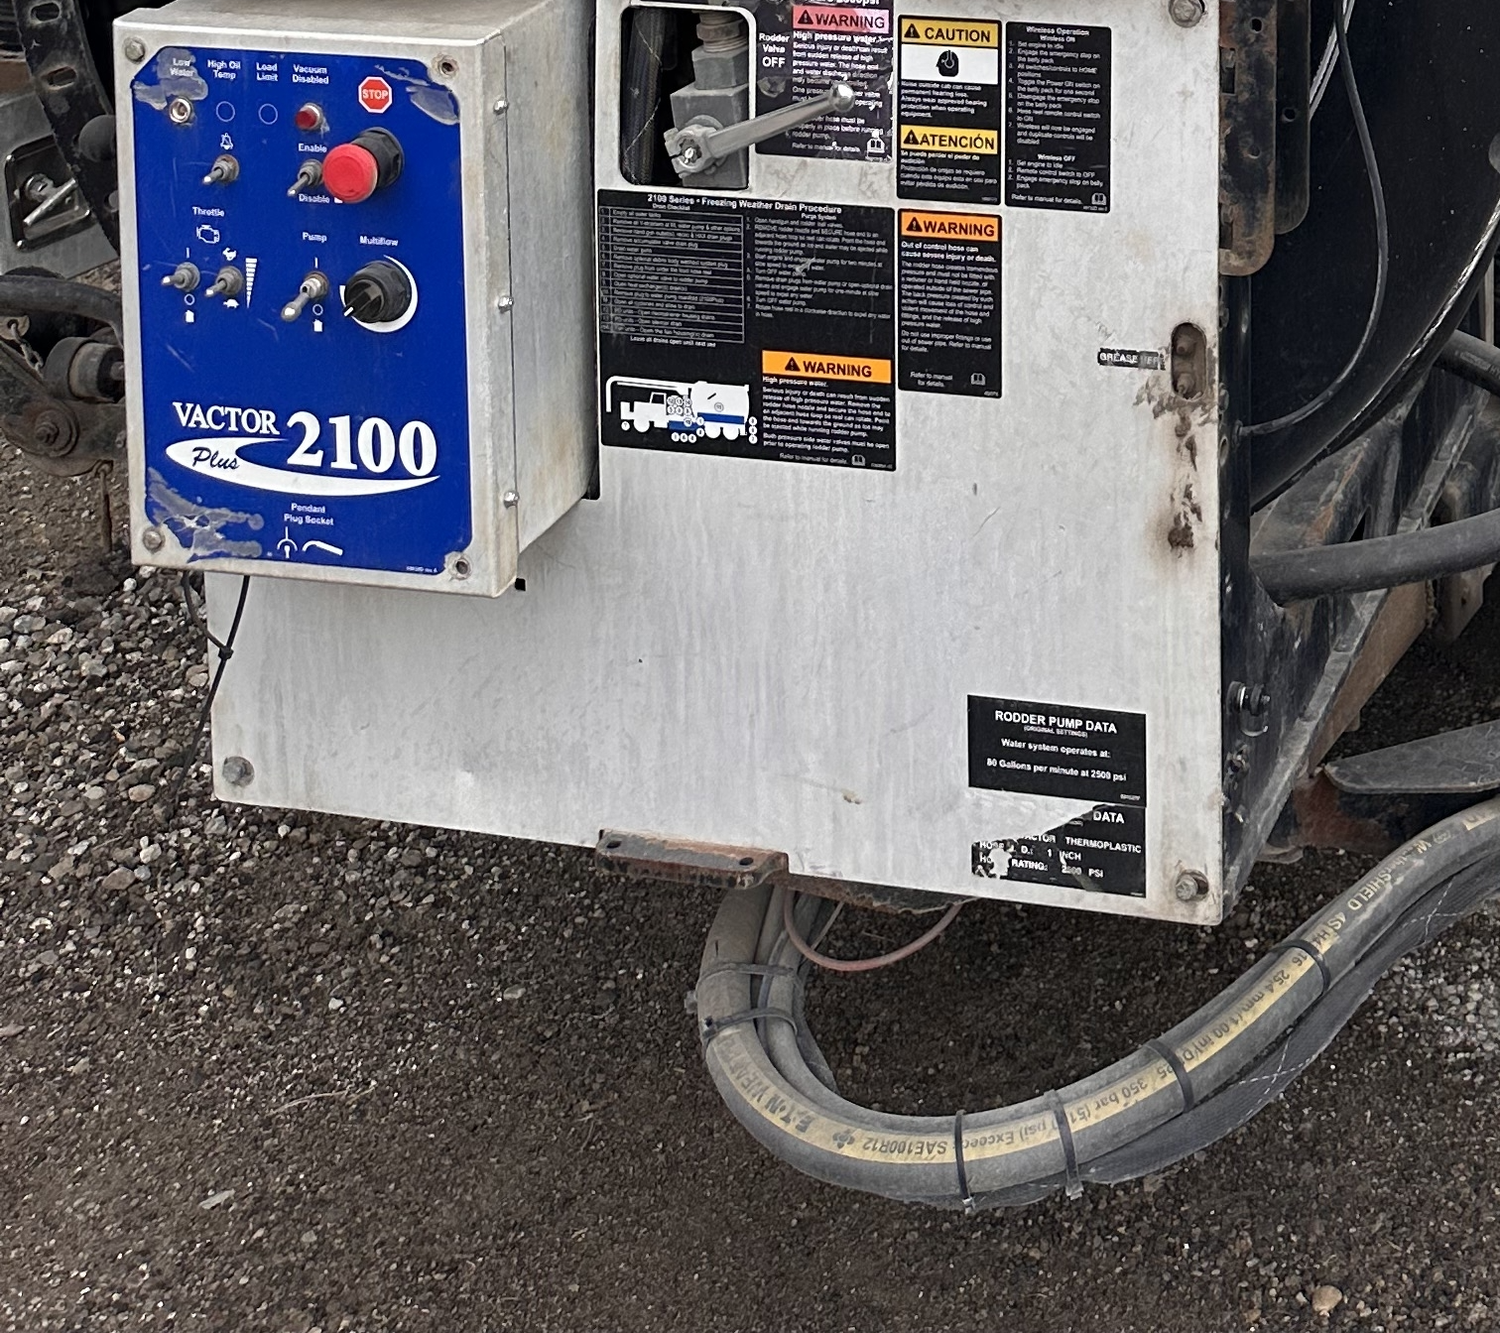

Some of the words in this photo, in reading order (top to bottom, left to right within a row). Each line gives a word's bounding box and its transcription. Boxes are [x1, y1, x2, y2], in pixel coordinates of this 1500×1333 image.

[815, 13, 885, 29] WARNING
[759, 33, 790, 43] Rodder
[793, 31, 812, 41] High
[815, 33, 851, 43] pressure
[925, 27, 990, 43] CAUTION
[763, 44, 786, 54] Valve
[207, 59, 228, 70] High
[228, 60, 241, 70] Oil
[256, 62, 278, 72] Load
[293, 64, 328, 74] Vacuum
[763, 56, 786, 68] OFF
[213, 70, 236, 80] Temp
[256, 72, 278, 82] Limit
[292, 74, 329, 85] Disabled
[362, 88, 388, 100] STOP
[298, 143, 327, 153] Enable
[919, 134, 994, 150] ATENCIÓN
[298, 193, 330, 204] Disable
[669, 195, 694, 205] Series
[701, 197, 737, 209] Freezing
[738, 199, 773, 210] Weather
[775, 201, 797, 211] Drain
[799, 203, 842, 214] Procedure
[192, 207, 225, 217] Throttle
[923, 220, 995, 237] WARNING
[302, 232, 327, 243] Pump
[359, 235, 399, 247] Multiflow
[901, 241, 914, 249] Out
[915, 241, 922, 249] of
[948, 244, 965, 252] hose
[1100, 352, 1138, 364] GREASE
[803, 360, 872, 378] WARNING
[172, 401, 280, 435] VACTOR
[286, 411, 438, 477] 2100
[192, 446, 240, 470] Plus
[291, 502, 326, 514] Pendant
[283, 513, 304, 525] Plug
[305, 515, 334, 526] Socket
[995, 710, 1046, 726] RODDER
[1049, 716, 1083, 729] PUMP
[1086, 720, 1117, 734] DATA
[1001, 738, 1026, 749] Water
[1028, 741, 1059, 753] system
[1060, 746, 1098, 757] operates
[1099, 750, 1111, 758] at:
[987, 758, 997, 767] 80
[999, 759, 1032, 771] Gallons
[1033, 764, 1048, 773] per
[1049, 765, 1079, 776] minute
[1081, 769, 1089, 777] at
[1112, 772, 1127, 782] psi
[1093, 810, 1125, 824] DATA
[1024, 834, 1056, 844] ACTOR
[1065, 836, 1142, 854] THERMOPLASTIC
[1047, 849, 1053, 858] 1
[1011, 858, 1048, 872] RATING:
[1088, 868, 1103, 878] PSI
[1265, 969, 1290, 993] 25.4
[1242, 991, 1265, 1012] mm
[1122, 1078, 1148, 1099] 350
[1095, 1095, 1120, 1111] bar
[1020, 1121, 1047, 1142] psi)
[863, 1136, 948, 1155] SAE100R12
